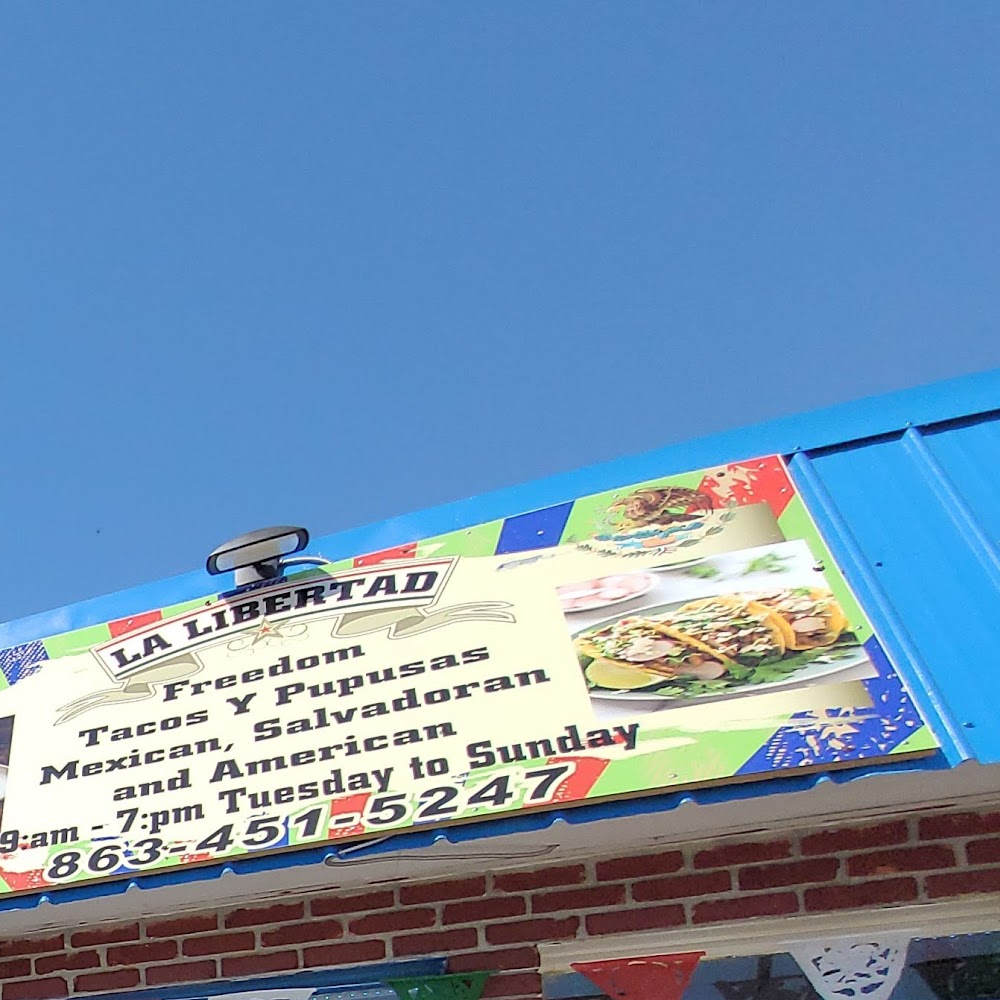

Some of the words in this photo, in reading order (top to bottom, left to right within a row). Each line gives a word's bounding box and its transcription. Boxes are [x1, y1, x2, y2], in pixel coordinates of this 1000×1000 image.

[110, 633, 173, 669] LA
[183, 571, 440, 640] LIBERTAD
[77, 708, 209, 748] Tacos
[226, 692, 258, 716] Y
[273, 645, 491, 706] Pupusas
[162, 644, 366, 702] Freedom
[38, 736, 236, 787] Mexican,
[253, 667, 552, 742] Salvadoran
[112, 767, 193, 802] and
[208, 720, 458, 784] American
[115, 802, 206, 836] 7:pm
[217, 766, 395, 815] Tuesday
[409, 755, 450, 781] to
[465, 721, 640, 771] Sunday
[46, 764, 571, 881] 863-451-5247
